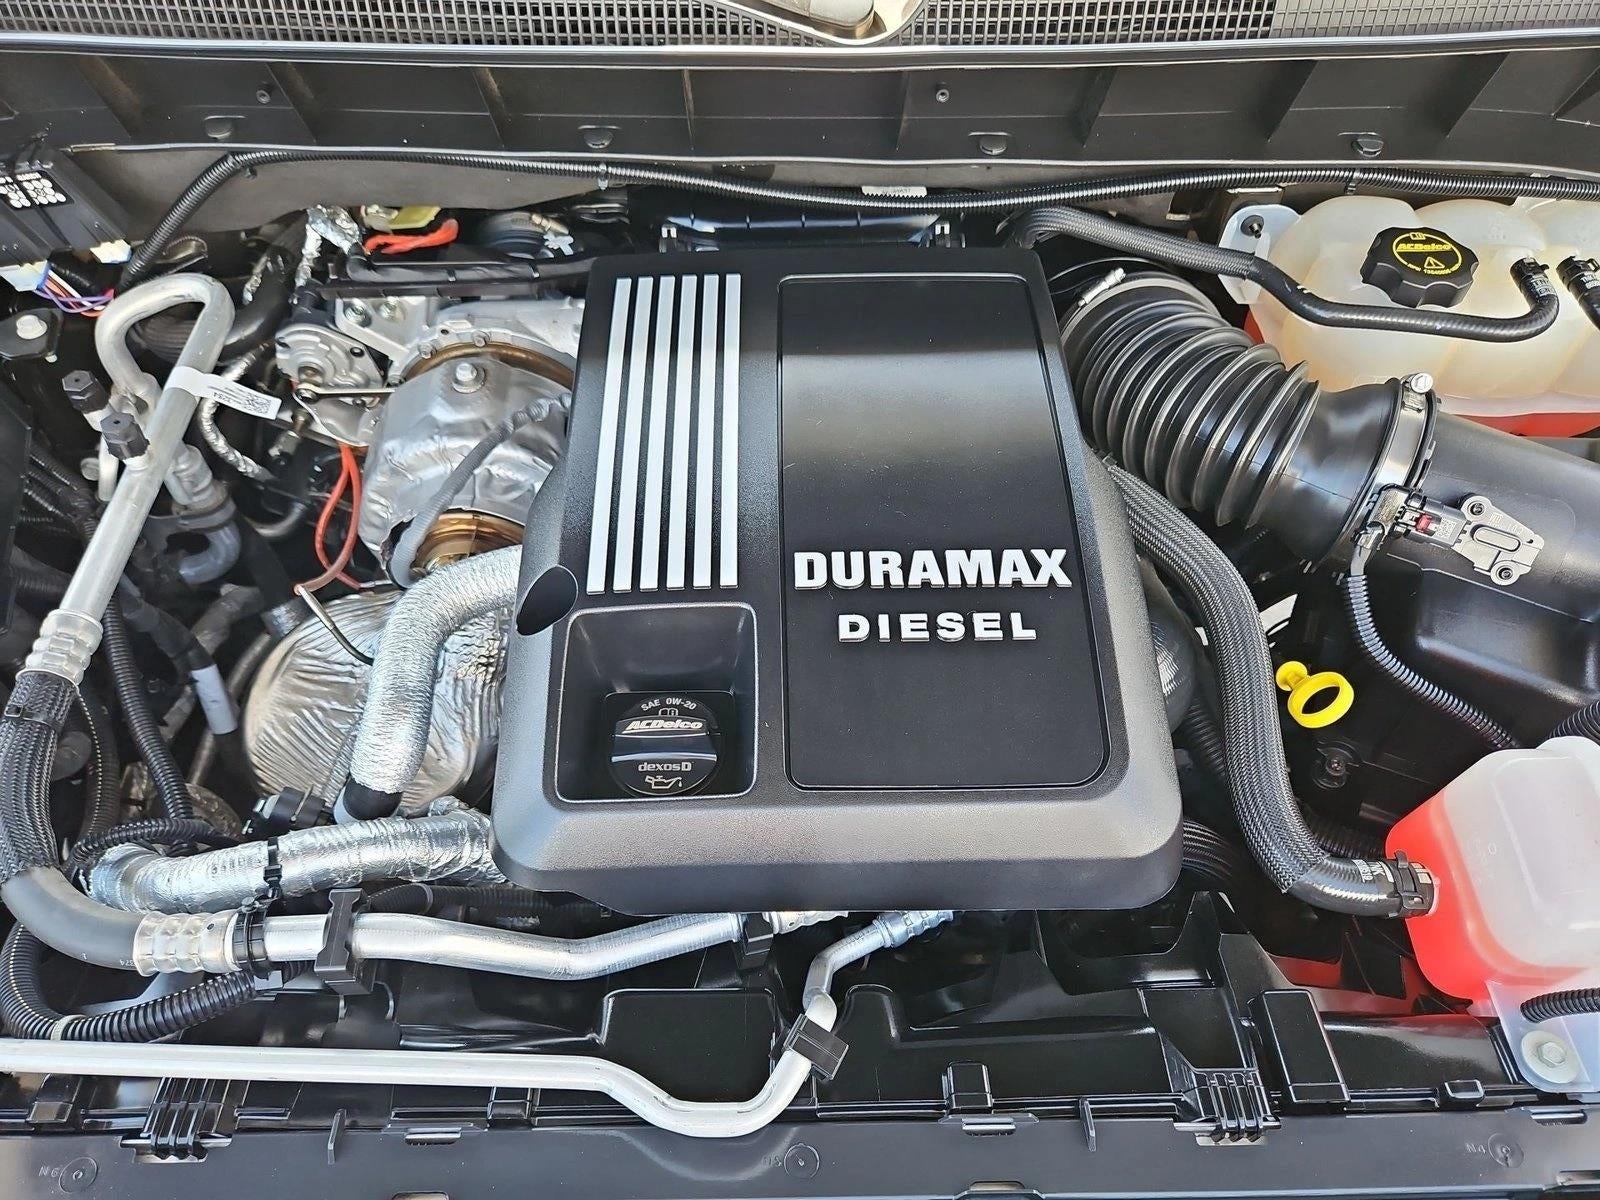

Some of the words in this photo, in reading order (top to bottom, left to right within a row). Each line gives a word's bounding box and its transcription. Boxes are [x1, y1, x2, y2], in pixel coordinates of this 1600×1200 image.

[1396, 243, 1452, 252] ACDelco
[794, 549, 1072, 589] DURAMAX
[838, 611, 1037, 643] DIESEL
[641, 699, 661, 711] SAE
[665, 697, 697, 711] 0W-20
[624, 719, 703, 731] ACDelco
[638, 761, 692, 772] dexosD
